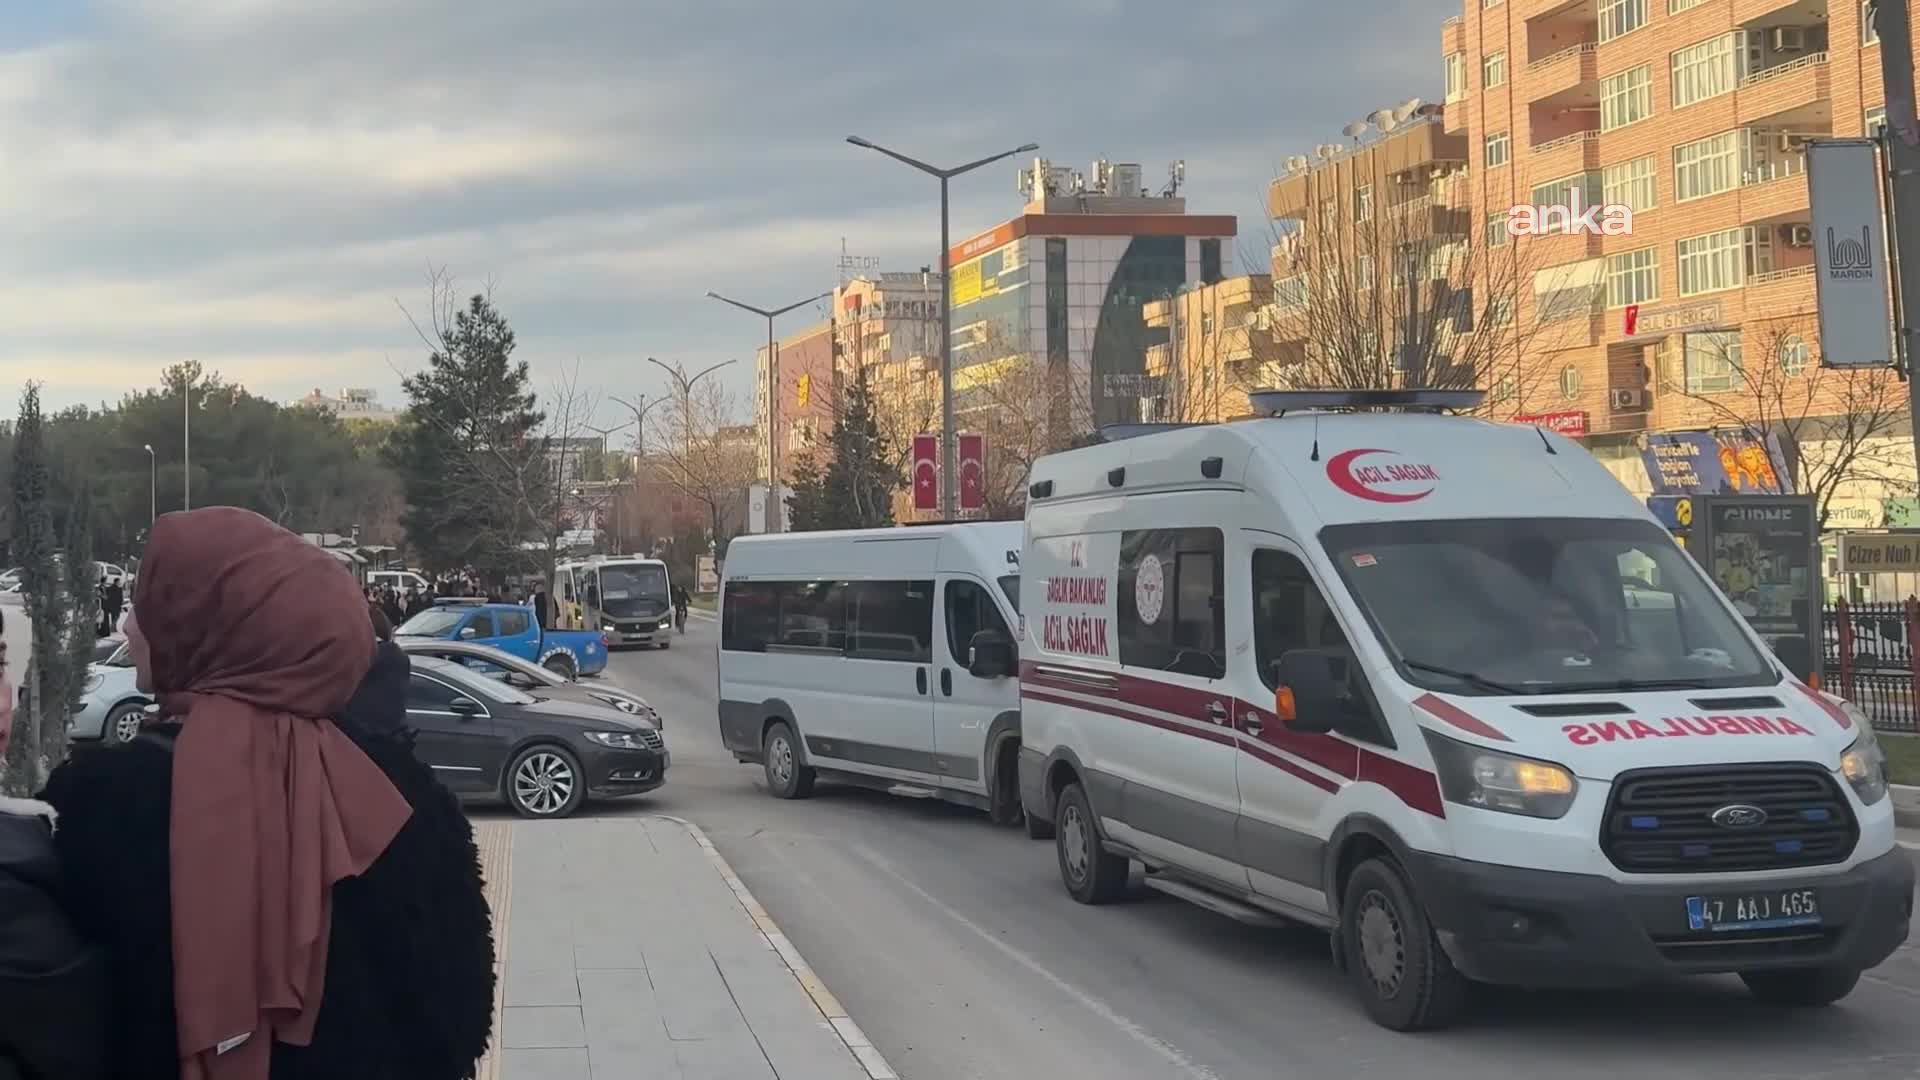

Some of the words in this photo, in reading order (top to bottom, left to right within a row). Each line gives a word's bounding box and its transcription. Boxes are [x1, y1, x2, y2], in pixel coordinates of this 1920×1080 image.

[1886, 544, 1912, 564] Nuh
[1067, 612, 1109, 657] SAĞLIK
[1702, 900, 1725, 921] 47
[1781, 890, 1816, 916] 465
